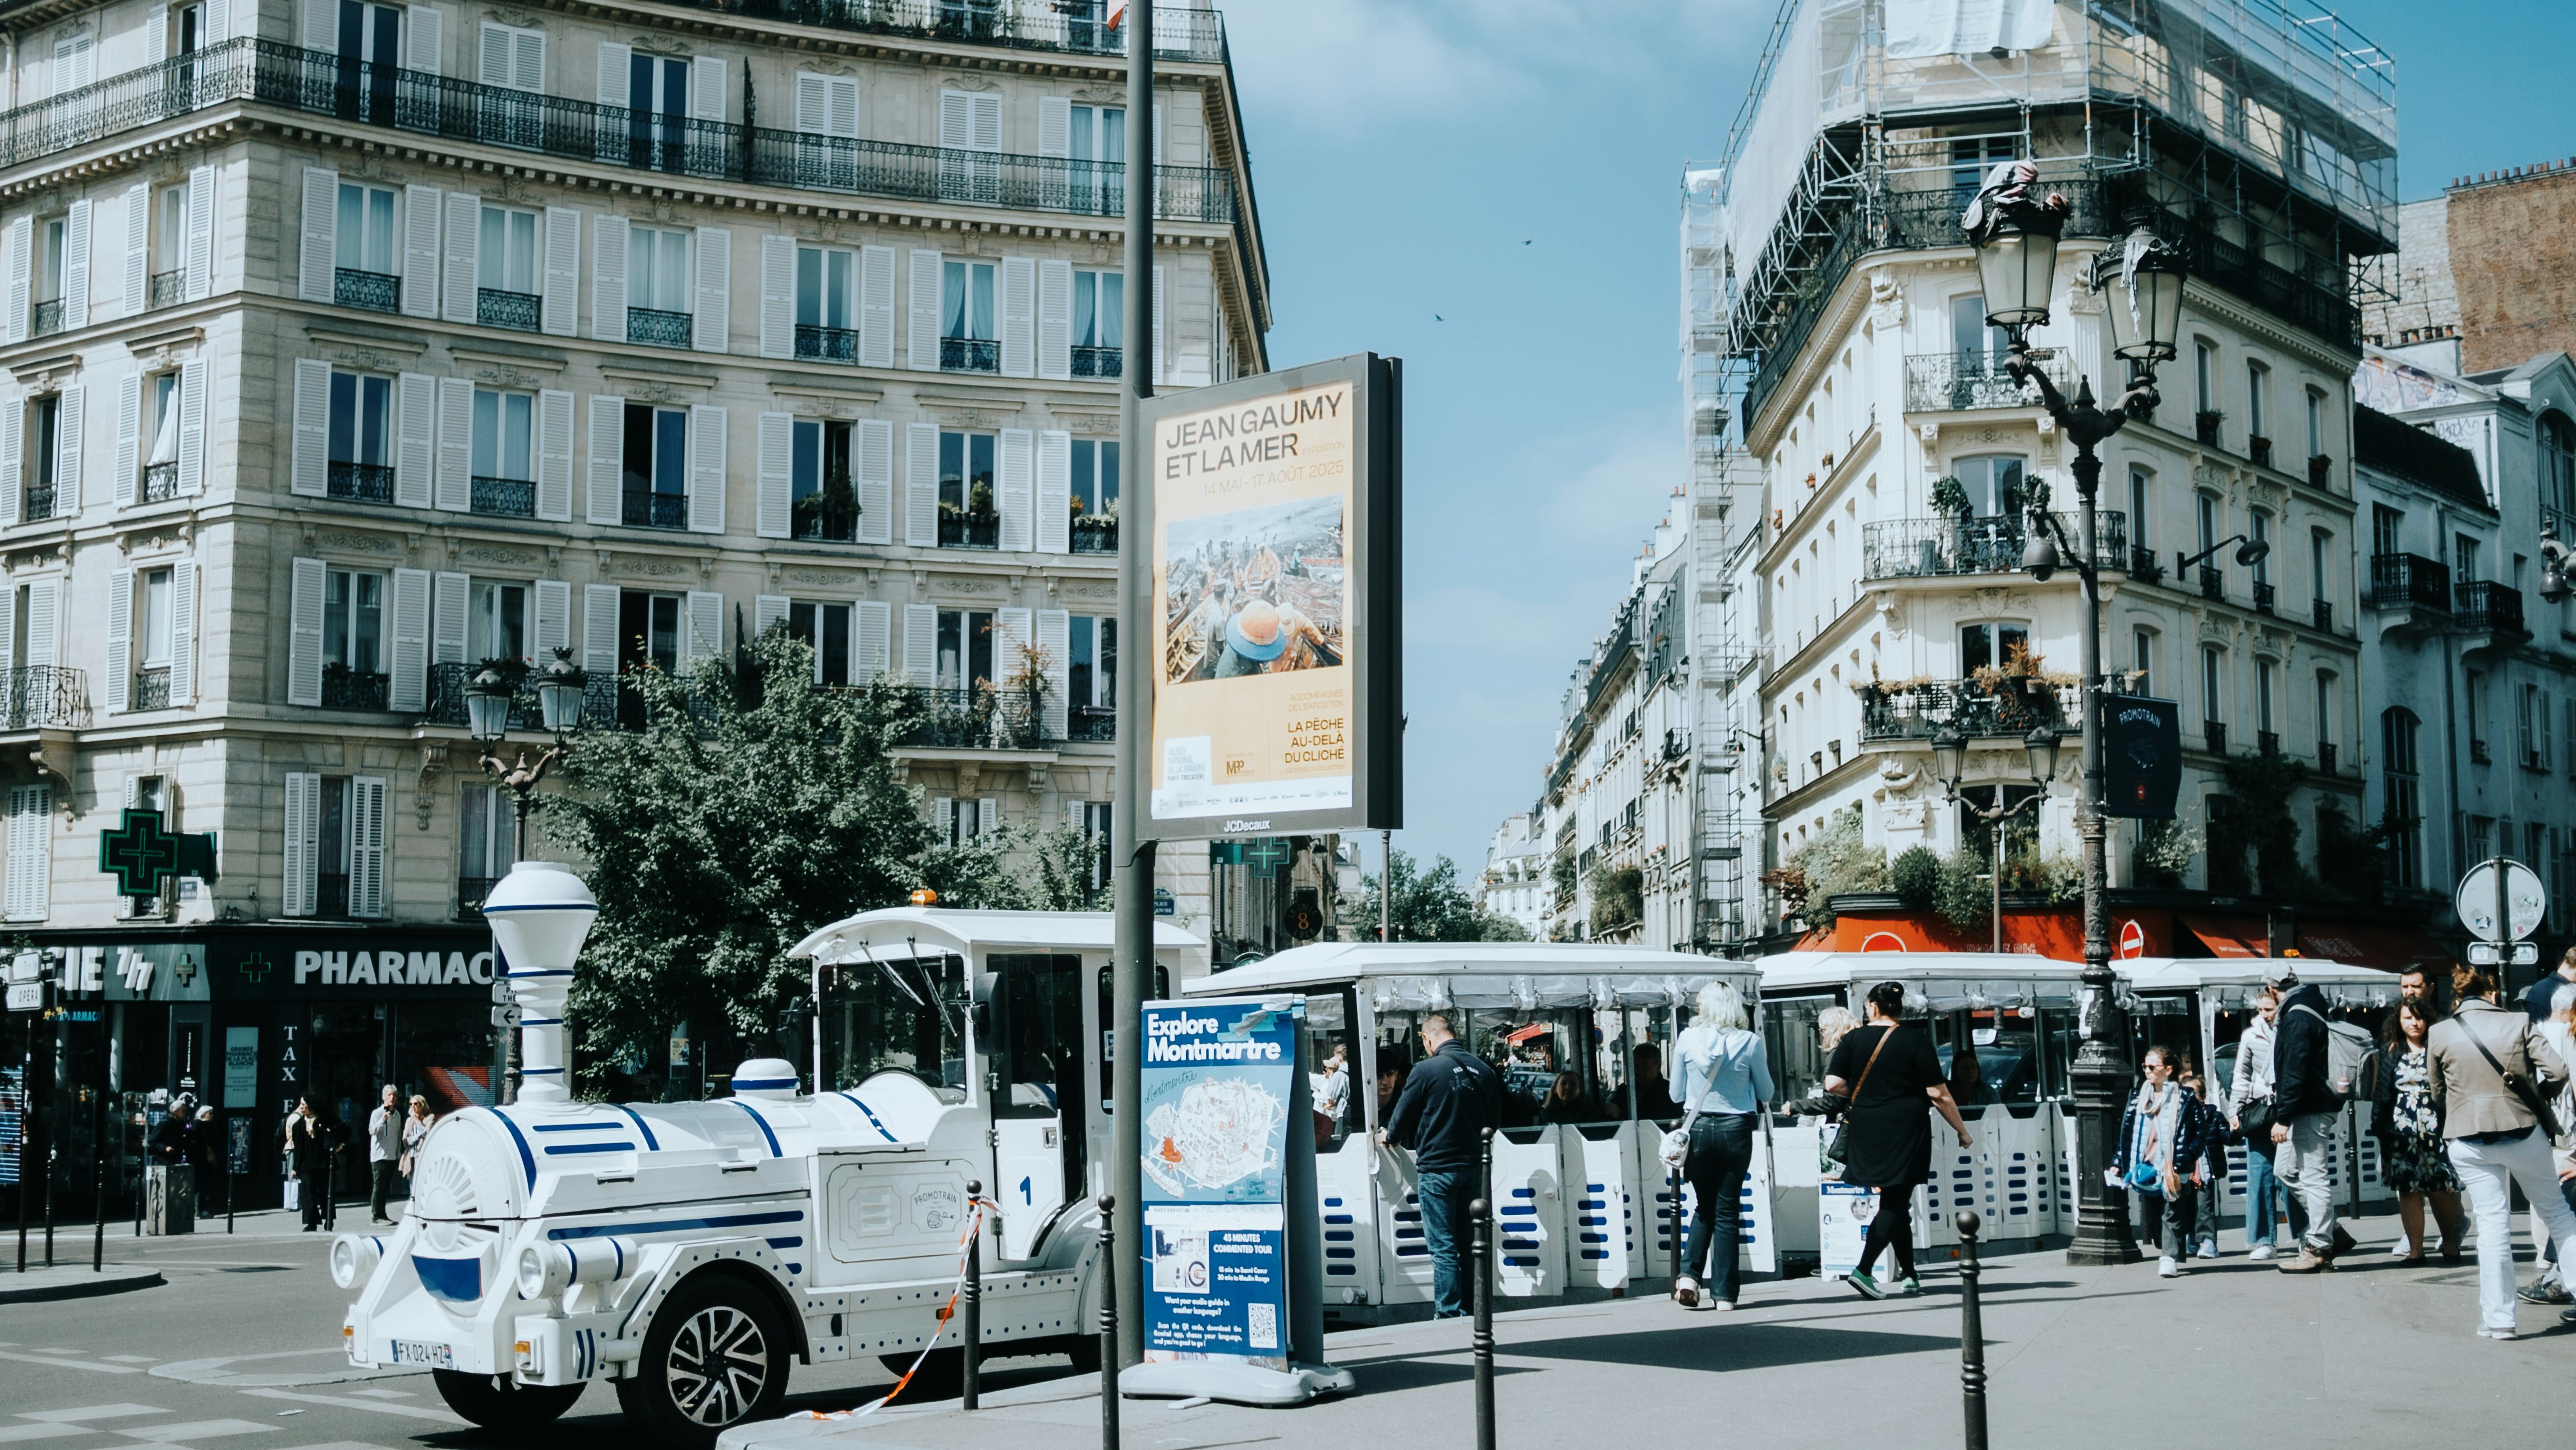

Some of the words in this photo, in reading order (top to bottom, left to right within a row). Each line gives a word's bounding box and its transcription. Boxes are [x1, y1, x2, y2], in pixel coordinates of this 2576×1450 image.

[1166, 413, 1235, 449] JEAN
[1240, 392, 1344, 434] GAUMY
[1167, 452, 1197, 480] ET
[1202, 446, 1236, 473] LA
[1241, 433, 1298, 466] MER
[1303, 441, 1344, 456] EXPOSITION
[1204, 483, 1216, 496] 14
[1220, 478, 1241, 494] MAI
[1252, 475, 1264, 487] 17
[1267, 465, 1304, 485] AOÛT
[1309, 460, 1344, 478] 2025
[1290, 689, 1343, 700] ACCOMPAGNÉE
[1288, 722, 1303, 733] LA
[1305, 717, 1344, 731] PÊCHE
[2119, 708, 2161, 728] PROMOTRAIN
[1291, 731, 1344, 747] AU-DELÀ
[1285, 751, 1301, 763] DU
[1303, 746, 1344, 761] CLICHÉ
[1223, 820, 1271, 833] JCDecaux
[1298, 912, 1309, 929] 8
[295, 951, 494, 984] PHARMAC
[19, 989, 38, 1002] OPÉRA
[503, 993, 516, 1002] THÉ
[1148, 1011, 1218, 1041] Explore
[1147, 1036, 1281, 1062] Montmartre
[1144, 1071, 1197, 1104] Montmartre
[1020, 1176, 1032, 1206] 1
[1826, 1186, 1865, 1194] Montmartre
[914, 1191, 958, 1205] PROMOTRAIN
[1223, 1233, 1232, 1242] 45
[1232, 1233, 1261, 1242] MINUTES
[1213, 1244, 1254, 1254] COMMENTED
[1254, 1245, 1272, 1254] TOUR
[1254, 1275, 1269, 1283] Rouge
[1208, 1298, 1223, 1307] guide
[1193, 1307, 1222, 1316] language?
[1207, 1324, 1231, 1332] download
[1218, 1333, 1243, 1342] language,
